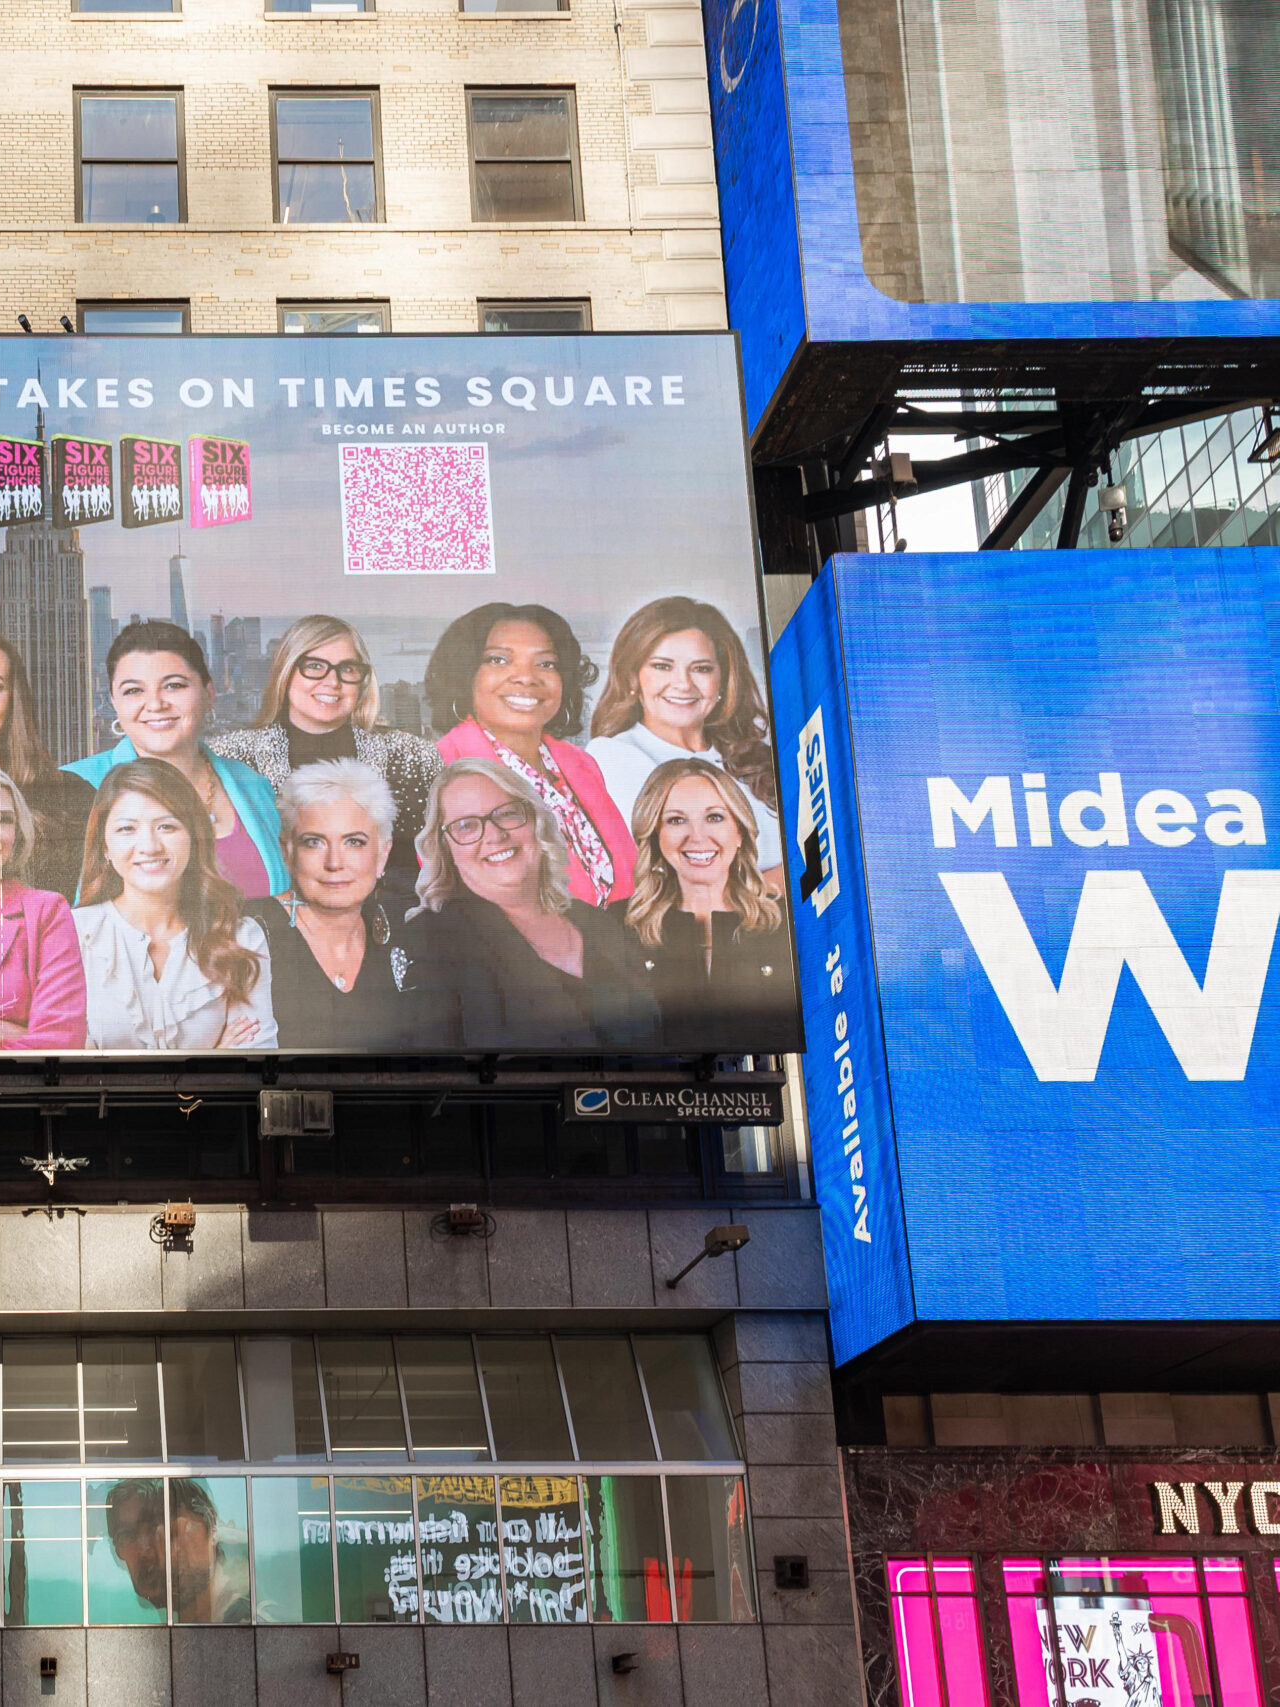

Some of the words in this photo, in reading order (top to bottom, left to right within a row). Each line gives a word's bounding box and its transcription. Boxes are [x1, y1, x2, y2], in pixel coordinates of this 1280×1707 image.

[179, 377, 254, 408] ON
[278, 376, 442, 408] TIMES
[465, 374, 686, 412] SQUARE
[322, 423, 395, 435] BECOME
[401, 424, 426, 435] AN
[433, 423, 506, 435] AUTHOR
[64, 464, 110, 476] FIGURE
[134, 464, 178, 476] FIGURE
[202, 464, 247, 476] FIGURE
[926, 771, 1268, 848] Midea
[825, 943, 844, 997] at
[677, 1106, 771, 1117] SPECTACOLOR
[834, 1011, 872, 1243] Available
[1154, 1481, 1280, 1534] NYC
[1043, 1657, 1114, 1688] ORK
